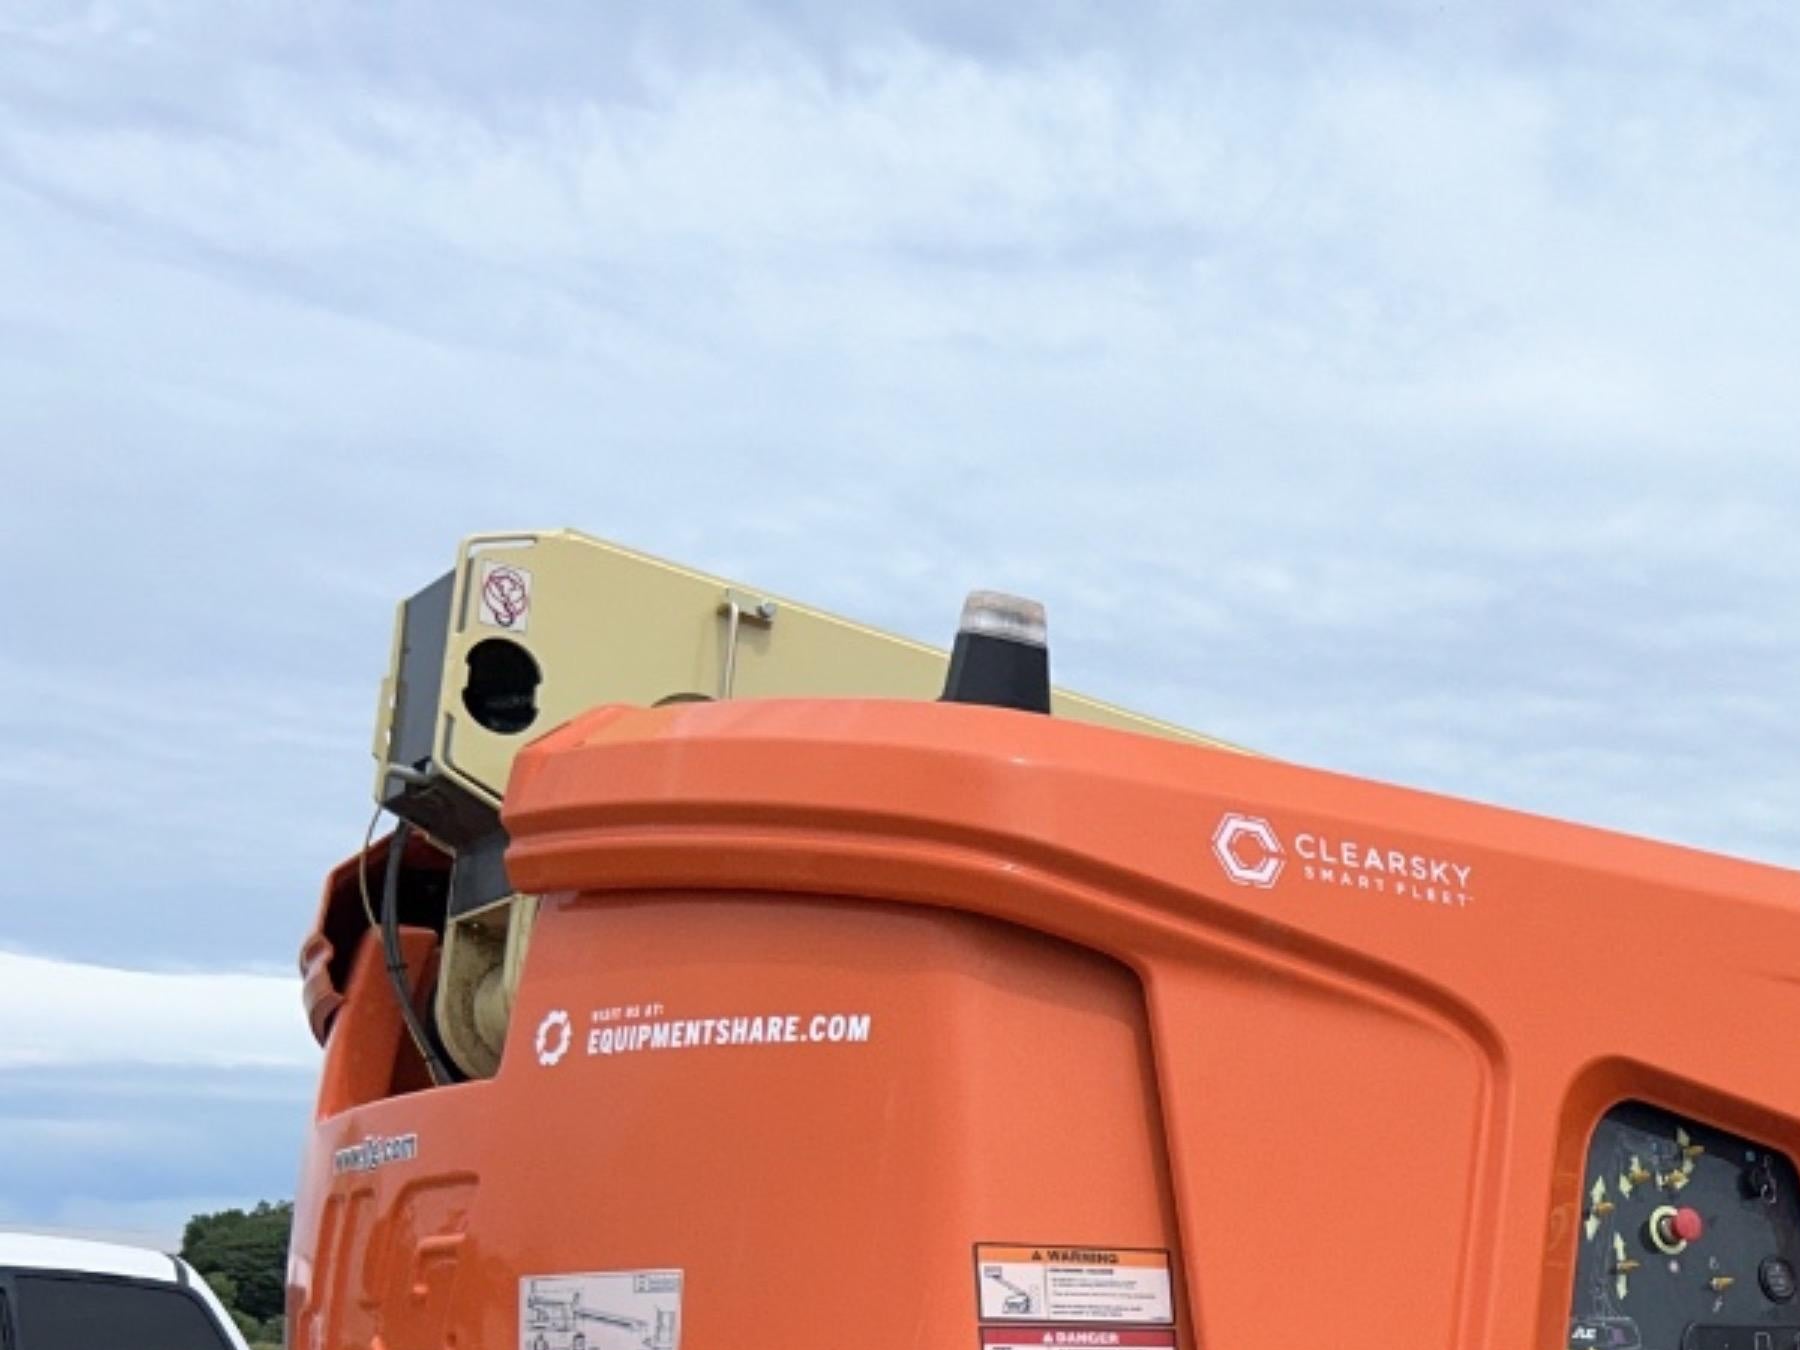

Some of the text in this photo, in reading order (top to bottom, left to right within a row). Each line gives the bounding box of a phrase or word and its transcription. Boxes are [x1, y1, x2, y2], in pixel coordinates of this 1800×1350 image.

[1294, 833, 1472, 889] CLEARSKY
[1304, 866, 1384, 892] SMART
[587, 1013, 871, 1056] EQUIPMENTSHARE.COM
[1047, 1250, 1119, 1265] WARNING
[1055, 1331, 1120, 1345] DANGER
